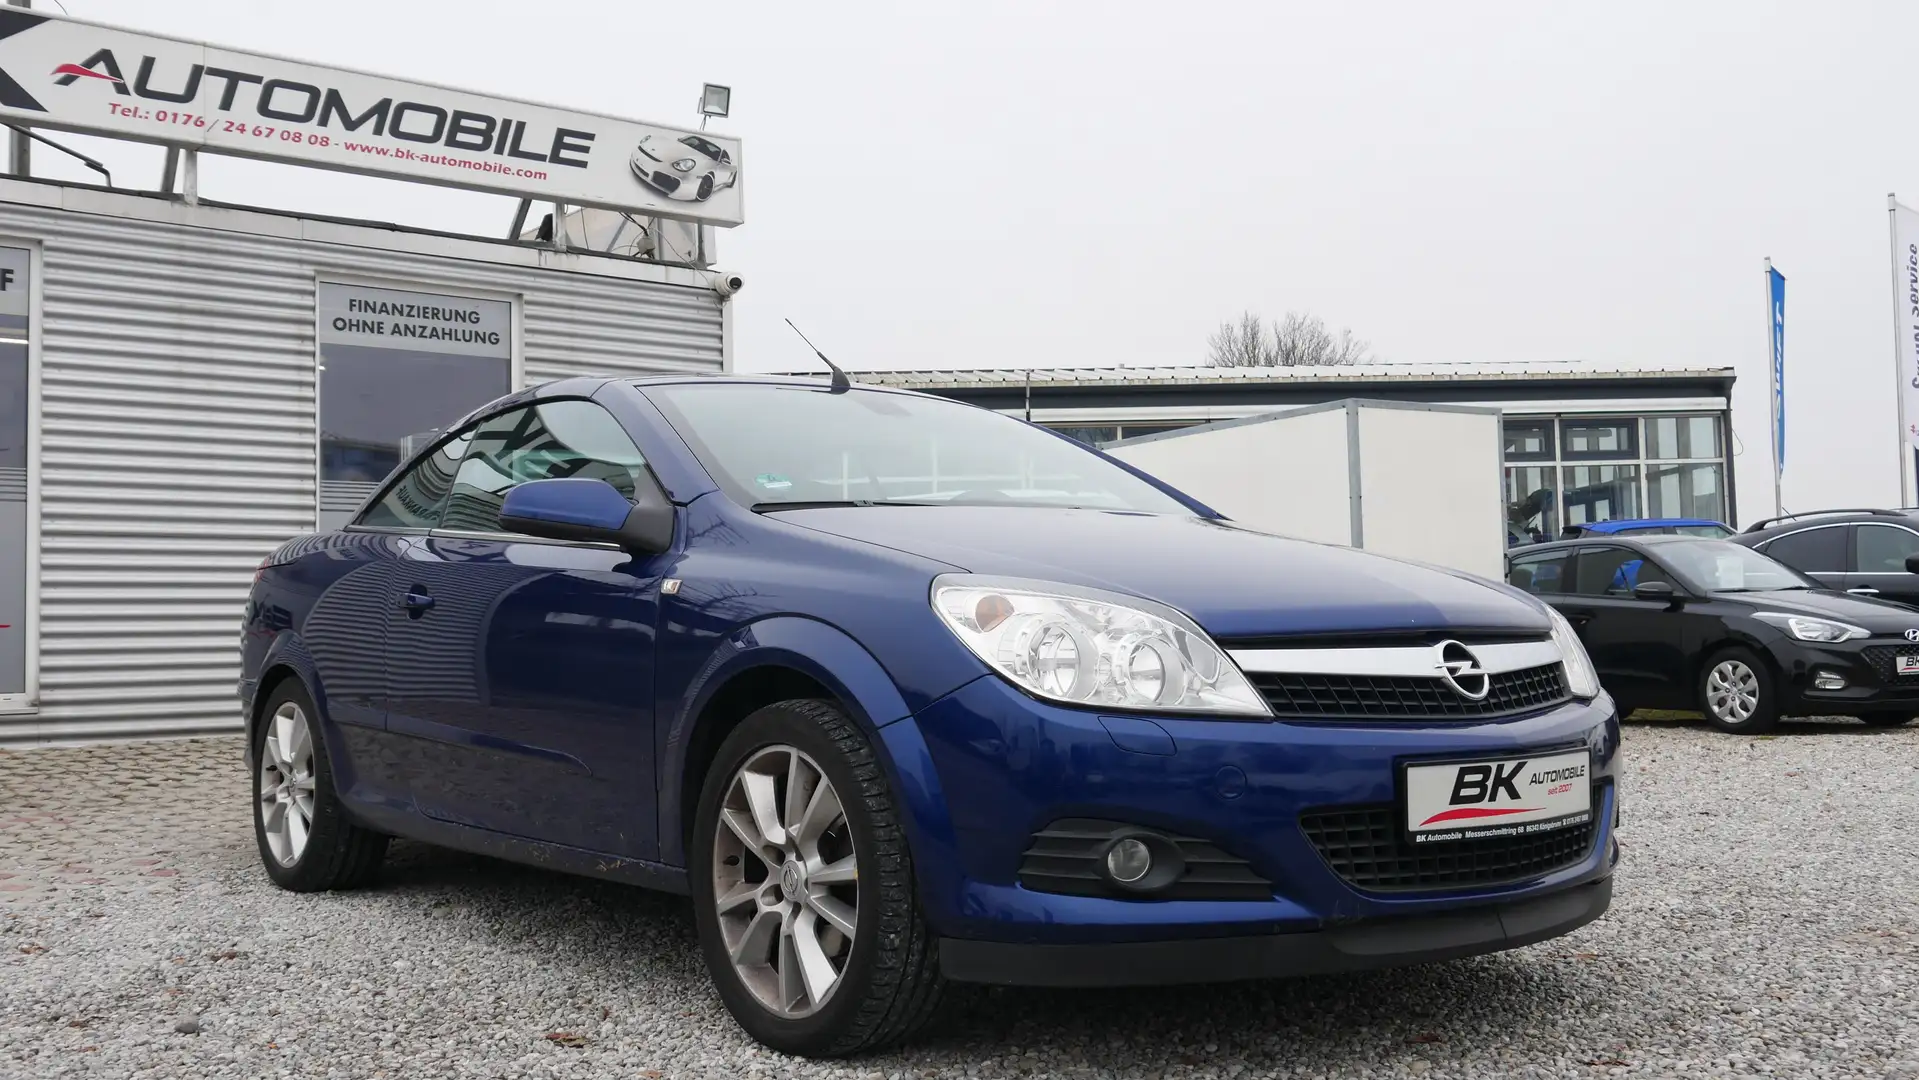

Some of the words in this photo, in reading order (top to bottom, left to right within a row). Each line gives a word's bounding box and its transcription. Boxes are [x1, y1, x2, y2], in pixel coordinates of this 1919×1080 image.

[51, 48, 596, 168] AUTOMOBILE
[109, 102, 150, 120] Tel.:
[155, 110, 205, 128] 0176
[223, 120, 247, 134] 24
[252, 125, 275, 138] 67
[280, 130, 302, 143] 08
[308, 134, 330, 147] 08
[344, 141, 548, 181] www.bk-automobile.com
[349, 298, 481, 325] FINANZIERUNG
[332, 317, 384, 335] OHNE
[390, 322, 501, 346] ANZAHLUNG
[1449, 761, 1528, 806] BK
[1529, 764, 1586, 786] AUTOMOBILE
[1416, 834, 1427, 843] BK
[1427, 832, 1463, 842] Automobile
